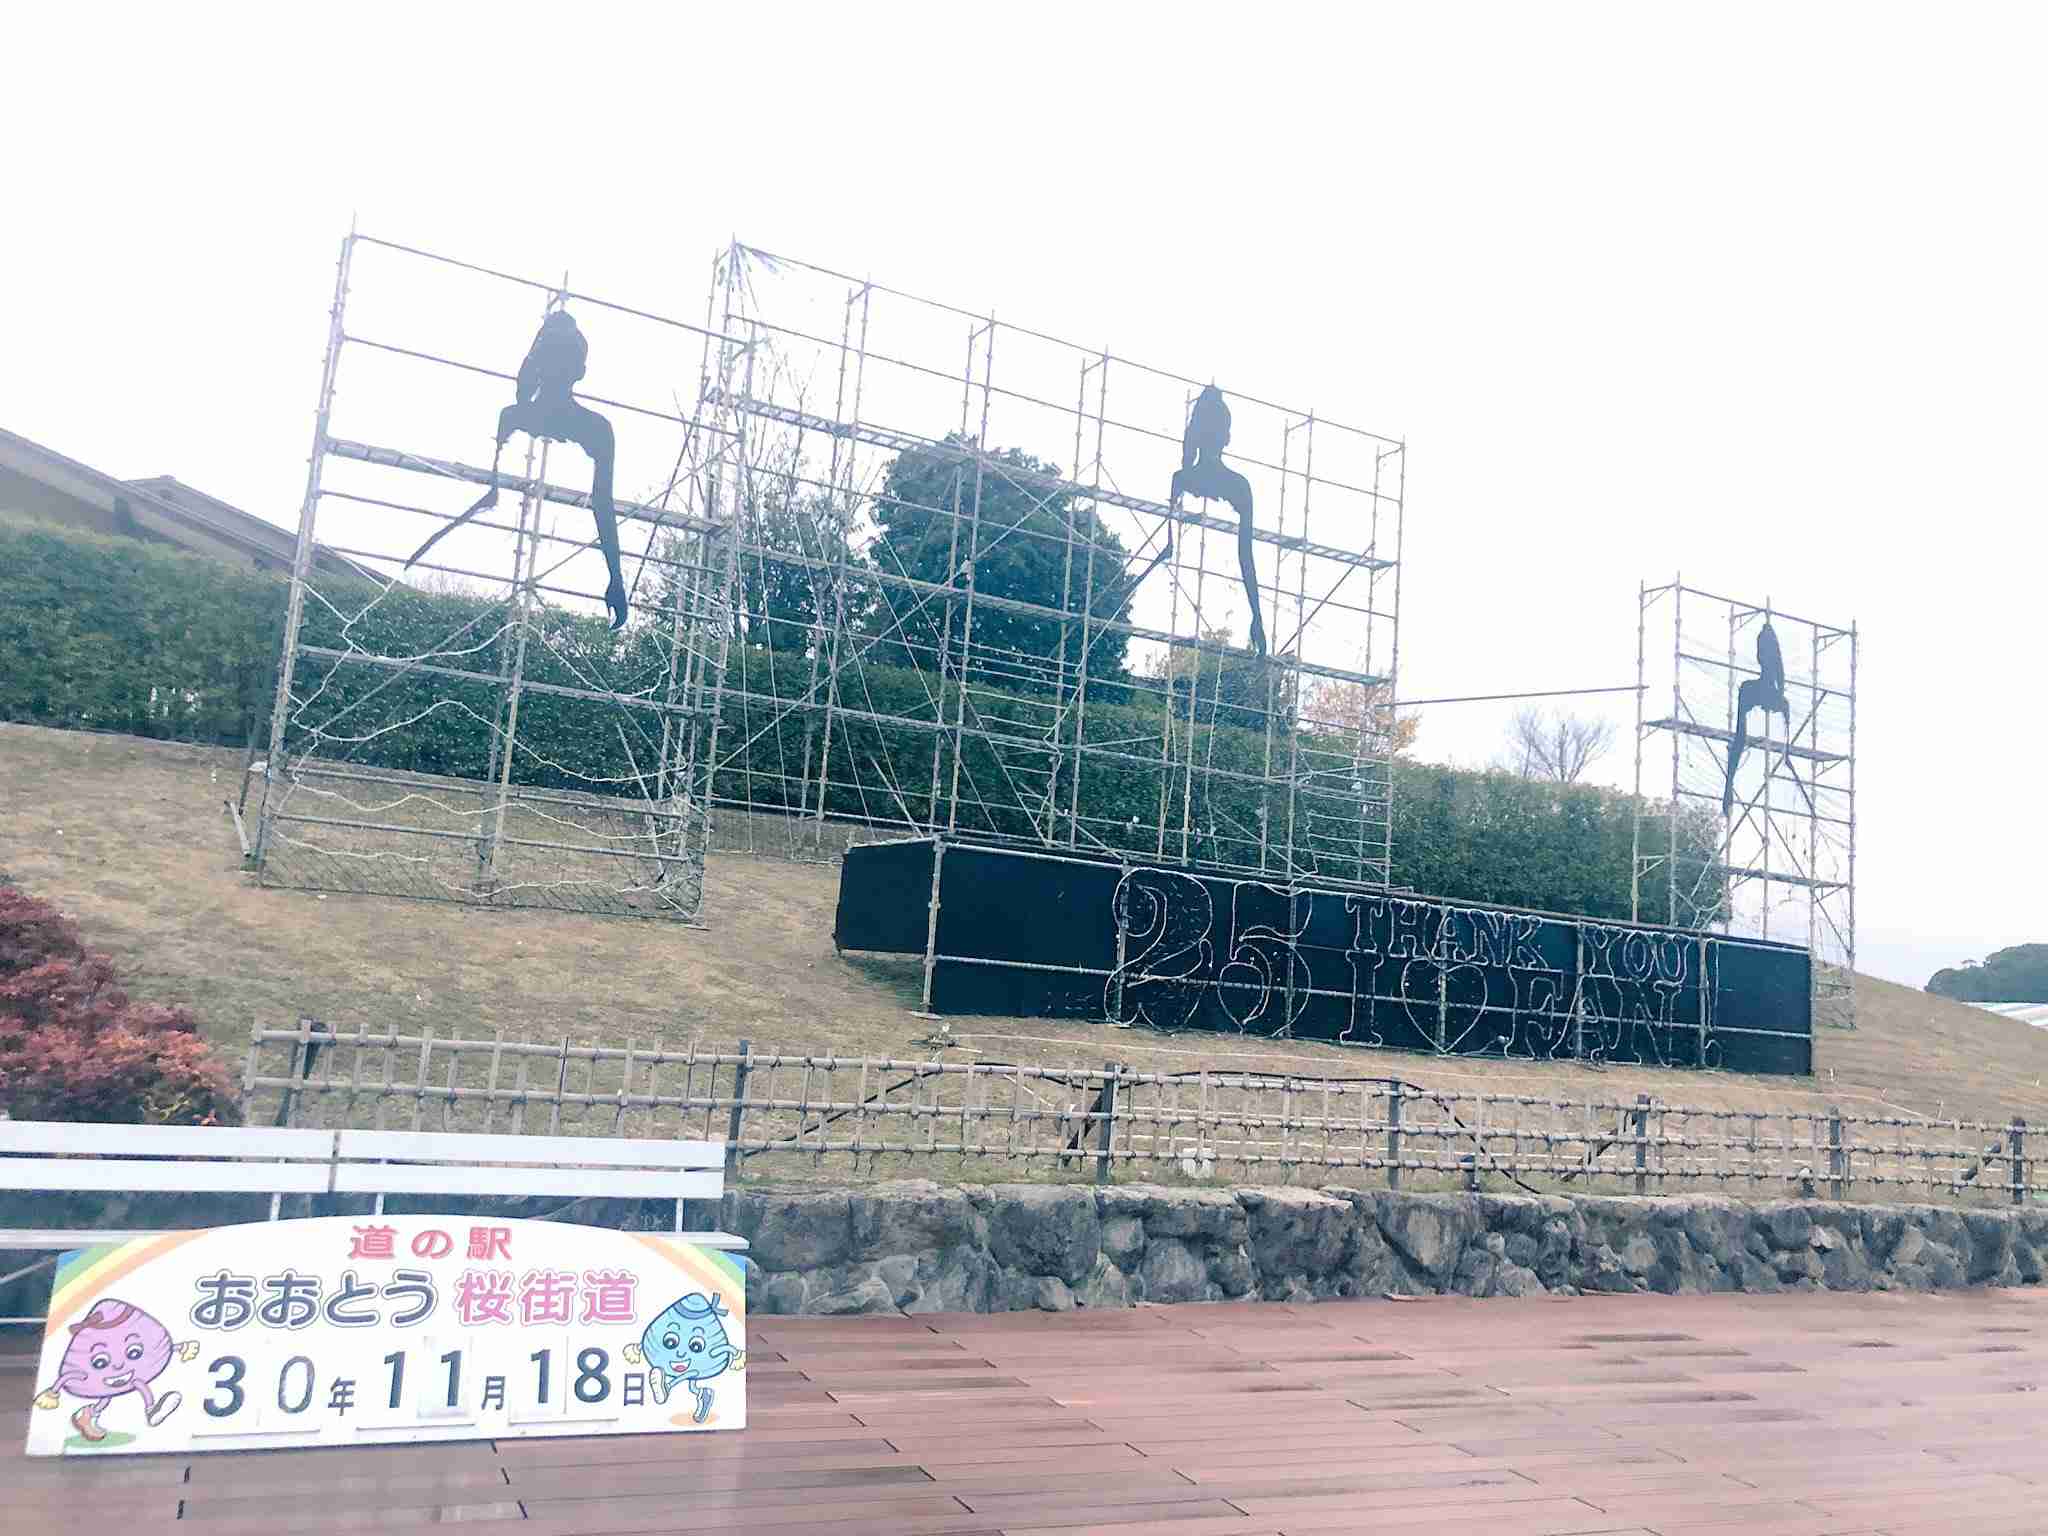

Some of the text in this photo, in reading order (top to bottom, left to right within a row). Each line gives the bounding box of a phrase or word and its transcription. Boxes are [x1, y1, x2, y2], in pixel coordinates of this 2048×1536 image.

[1104, 866, 1312, 1038] 25
[1345, 892, 1549, 968] THANK
[347, 1225, 513, 1261] 道の駅
[190, 1268, 639, 1330] おおとう 桜街道
